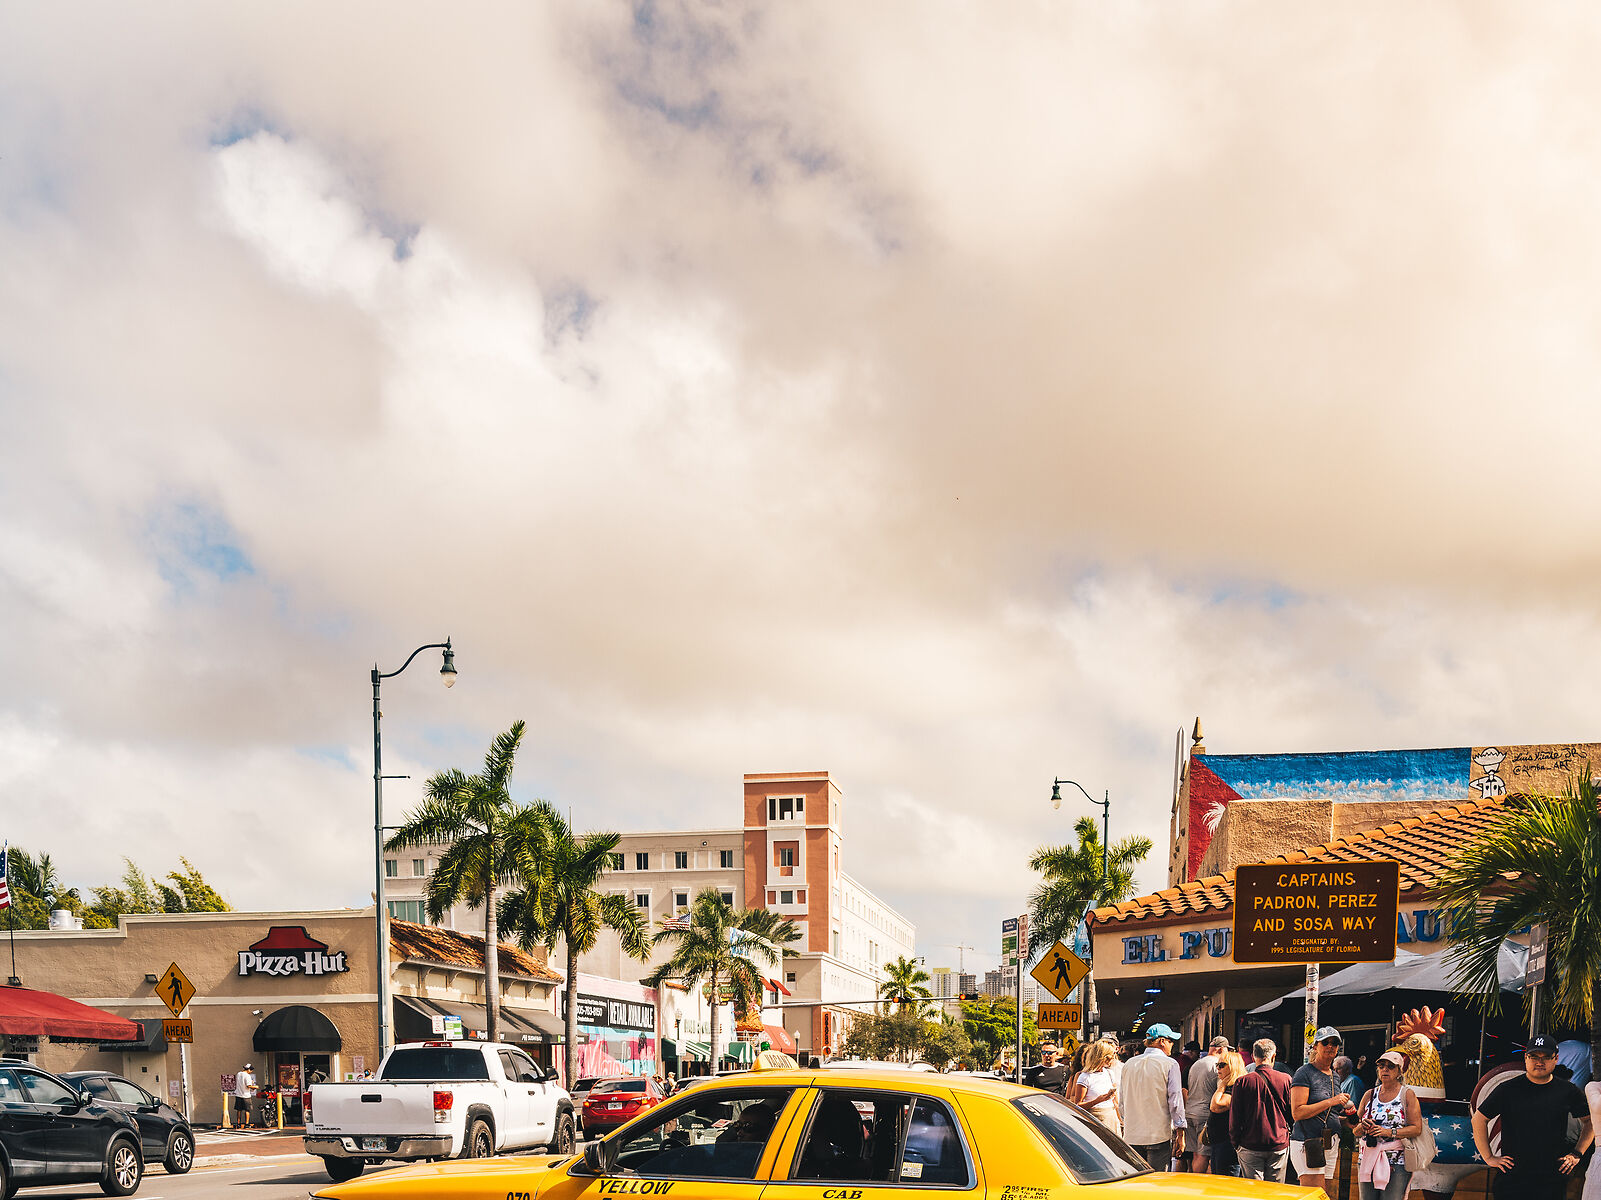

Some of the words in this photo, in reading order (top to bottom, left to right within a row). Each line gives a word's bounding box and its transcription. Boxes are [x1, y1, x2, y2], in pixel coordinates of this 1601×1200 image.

[1278, 872, 1354, 888] CAPTAINS
[1253, 895, 1320, 910] PADRON,
[1328, 893, 1378, 908] PEREZ
[1252, 918, 1285, 932] AND
[1293, 917, 1334, 931] SOSA
[1342, 916, 1377, 930] WAY
[1121, 934, 1166, 965] EL
[1179, 927, 1230, 960] PU
[1286, 946, 1324, 954] LEGISLATURE
[1336, 945, 1361, 953] FLORIDA
[1292, 938, 1328, 946] DESIGNATED
[238, 951, 300, 976] Pizza
[300, 951, 345, 975] Hut
[1041, 1010, 1079, 1023] AHEAD
[165, 1024, 191, 1036] AHEAD
[10, 1045, 28, 1053] Join
[763, 1053, 793, 1070] VACANT
[597, 1179, 676, 1195] YELLOW
[822, 1189, 863, 1200] CAB
